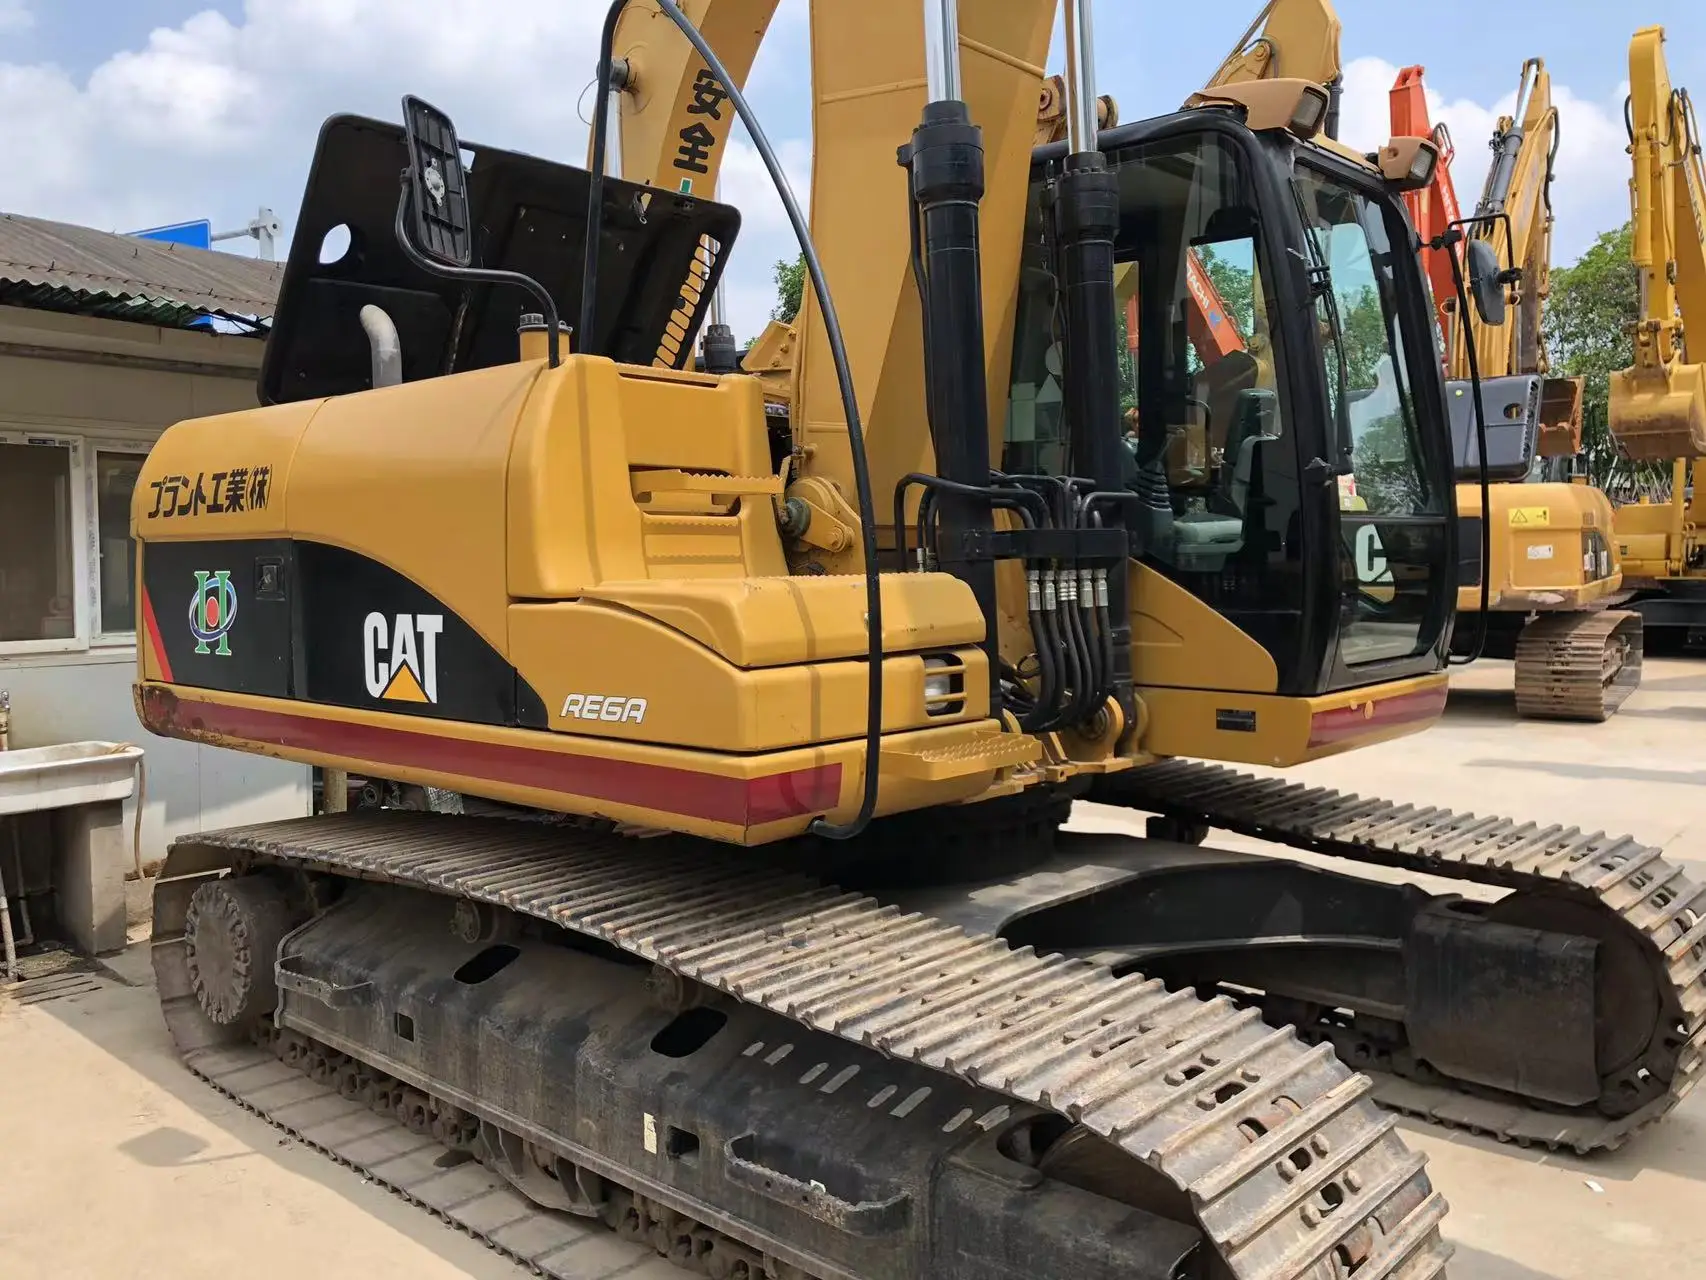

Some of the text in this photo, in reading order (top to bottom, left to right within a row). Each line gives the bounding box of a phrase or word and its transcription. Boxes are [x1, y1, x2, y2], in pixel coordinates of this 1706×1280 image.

[673, 68, 728, 174] 安全
[363, 611, 443, 704] CAT
[559, 693, 648, 724] REGA
